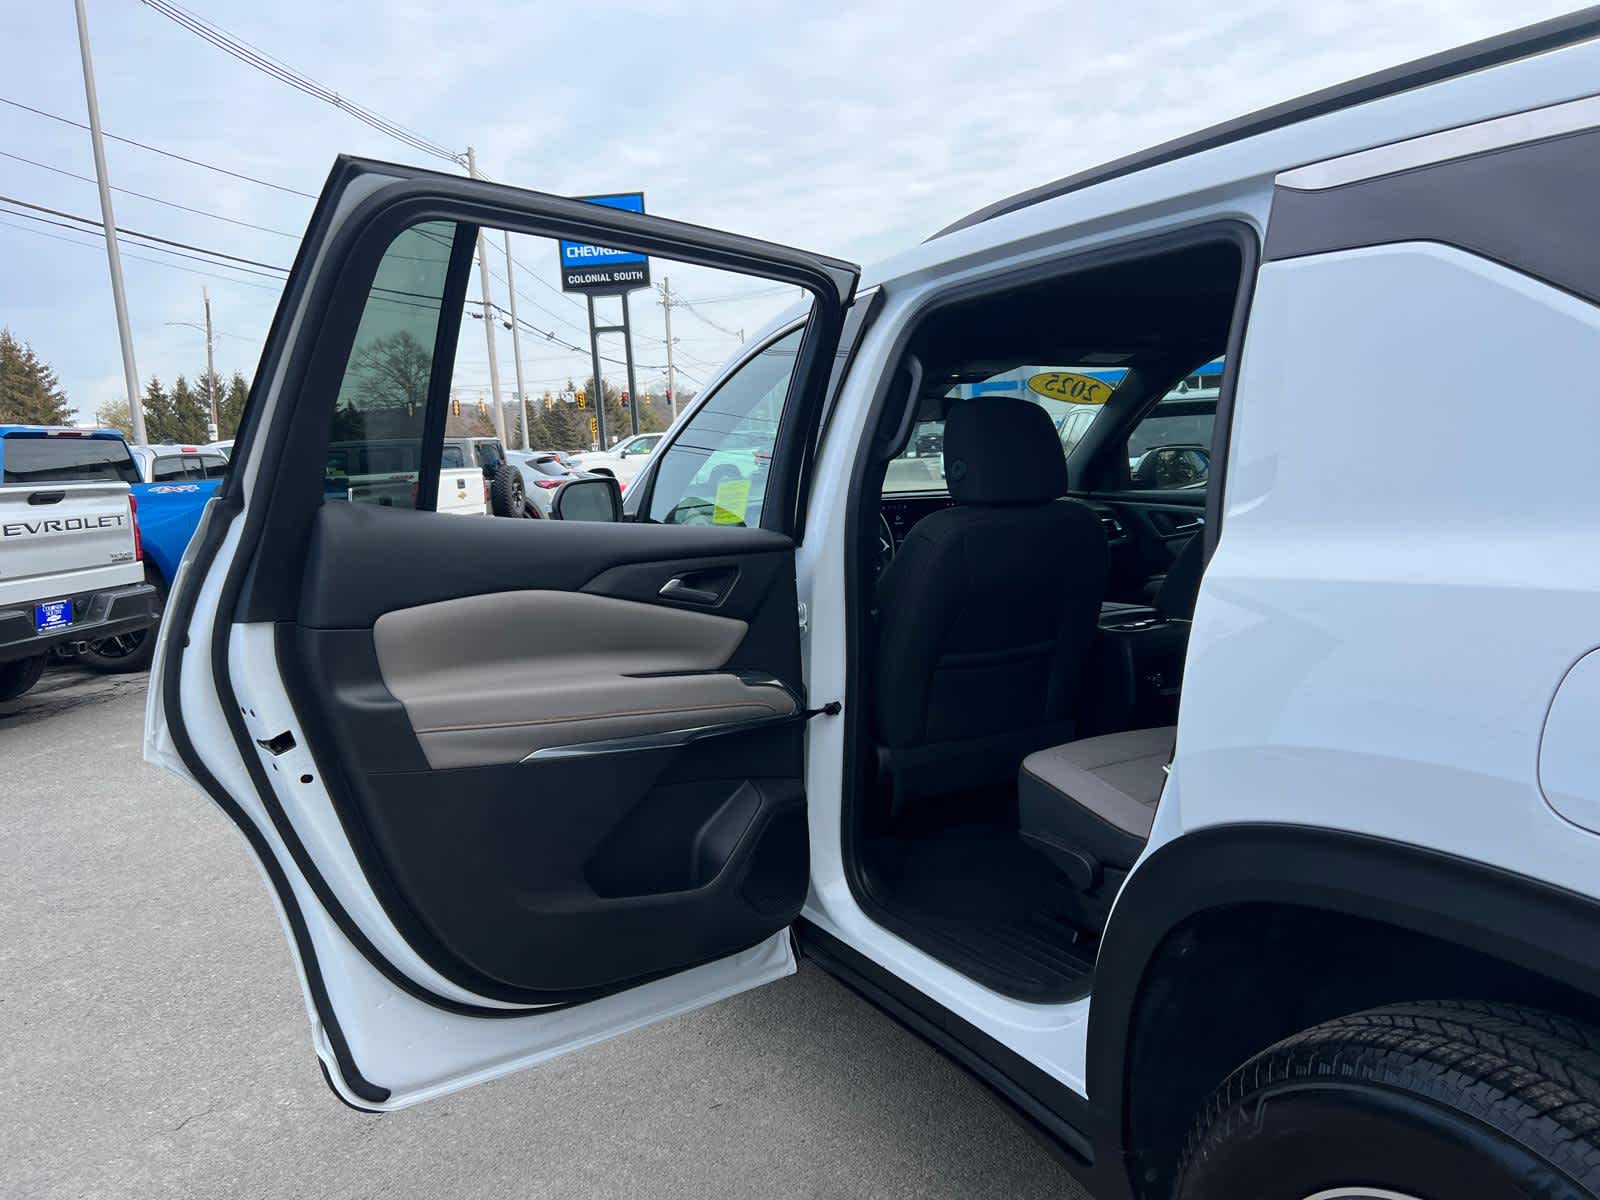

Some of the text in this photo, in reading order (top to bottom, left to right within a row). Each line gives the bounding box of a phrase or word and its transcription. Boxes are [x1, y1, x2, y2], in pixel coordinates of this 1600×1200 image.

[566, 244, 632, 258] CHEVRO
[568, 271, 643, 284] COLONIAL SOUTH
